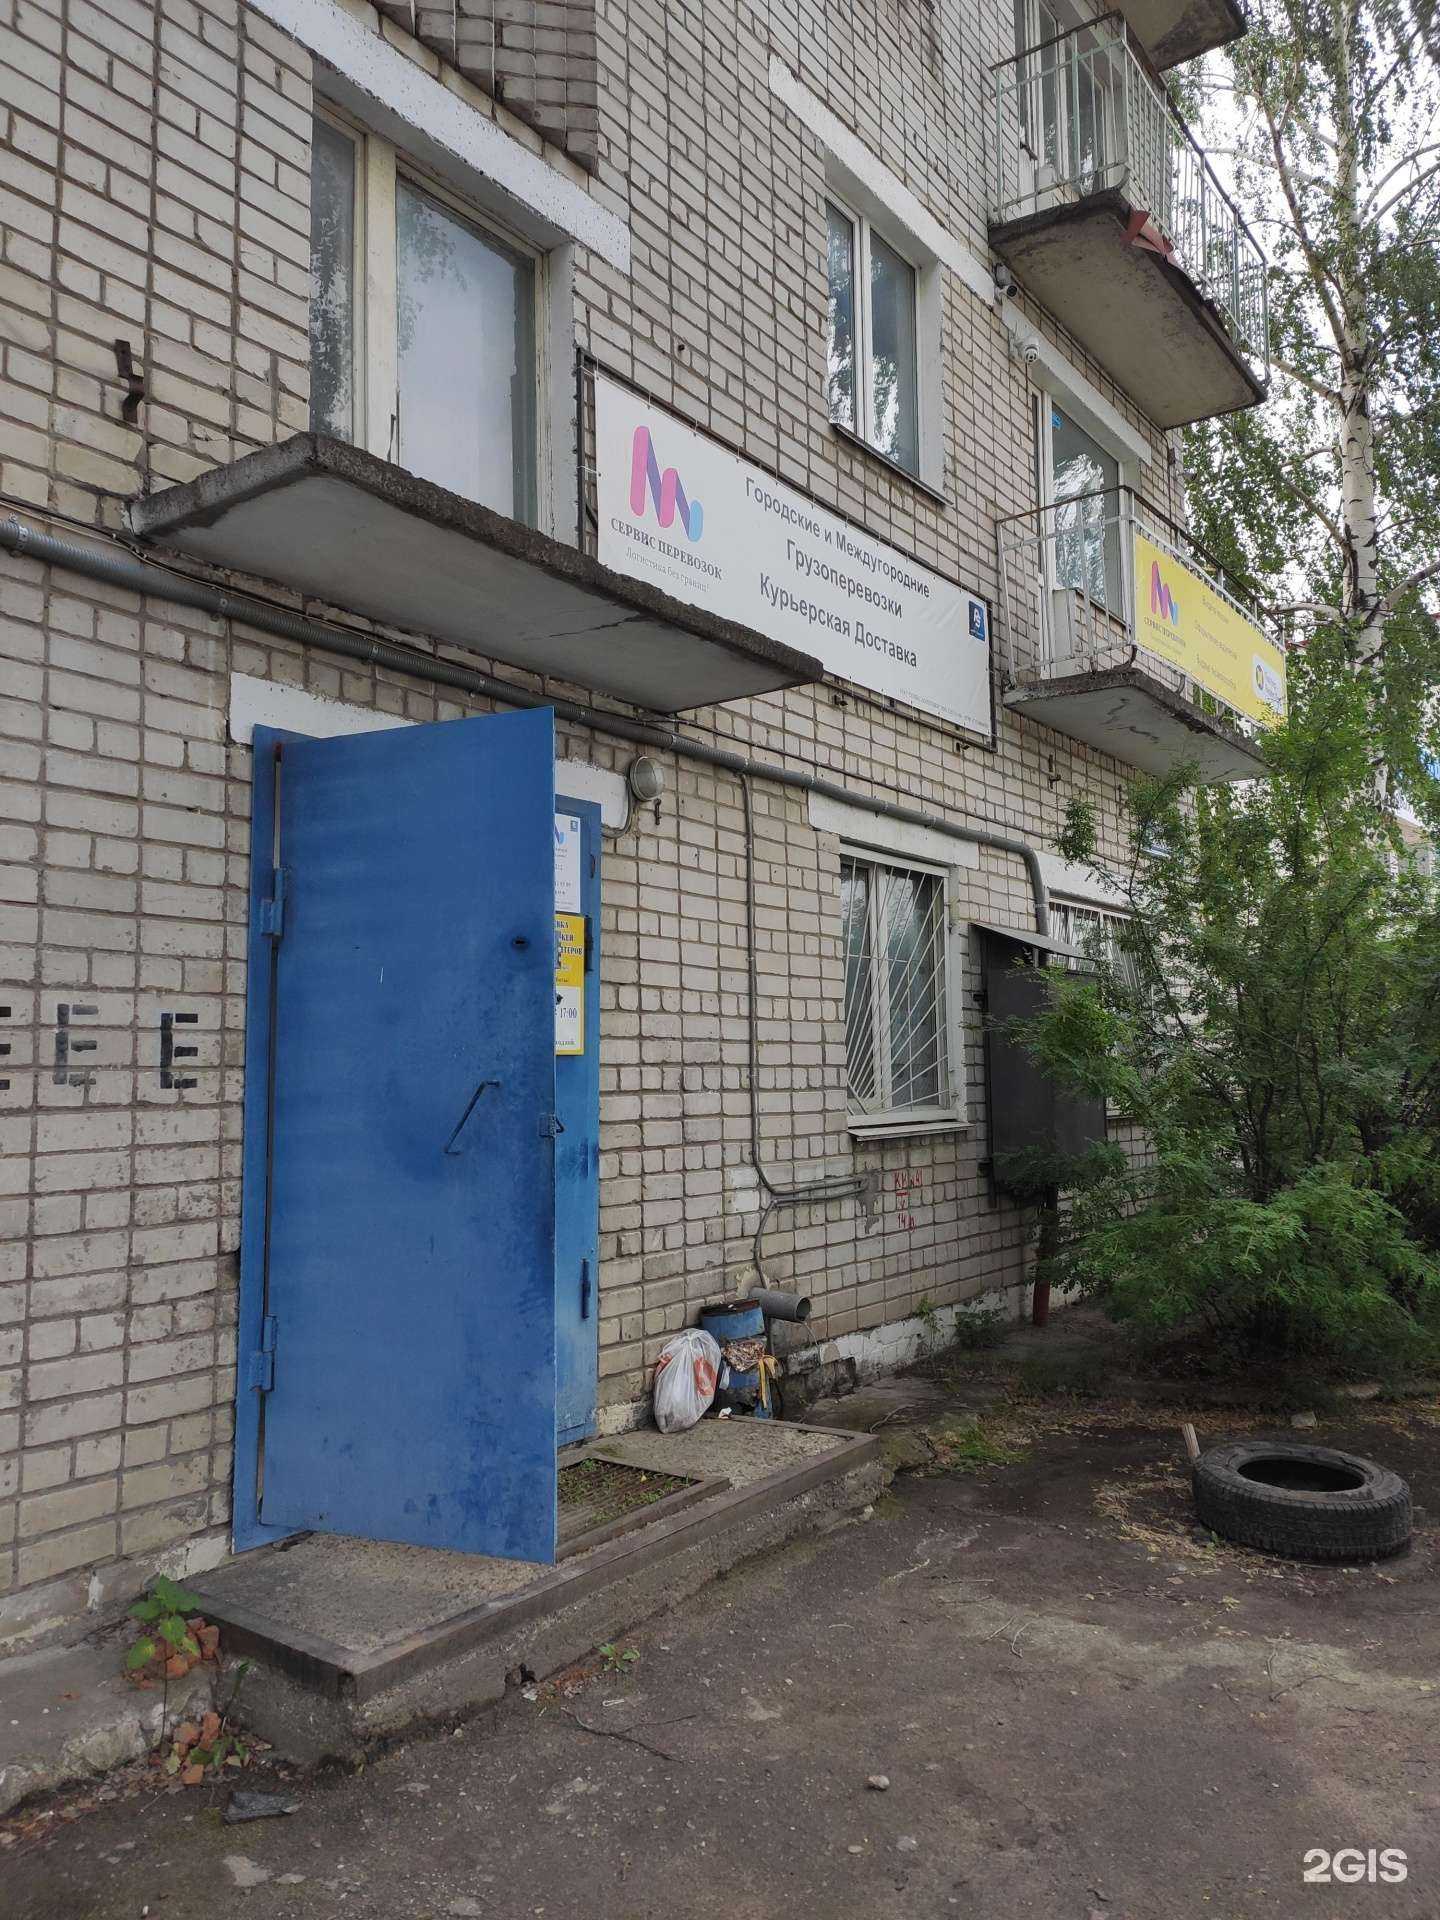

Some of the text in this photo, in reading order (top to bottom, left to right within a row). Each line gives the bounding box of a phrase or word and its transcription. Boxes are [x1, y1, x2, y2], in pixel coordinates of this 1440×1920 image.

[611, 518, 722, 580] СЕРВИС ПЕРЕВОЗОК
[745, 476, 931, 599] Городские и Междугородние
[786, 538, 903, 619] Грузоперевозки
[759, 572, 918, 668] Курьерская Доставка
